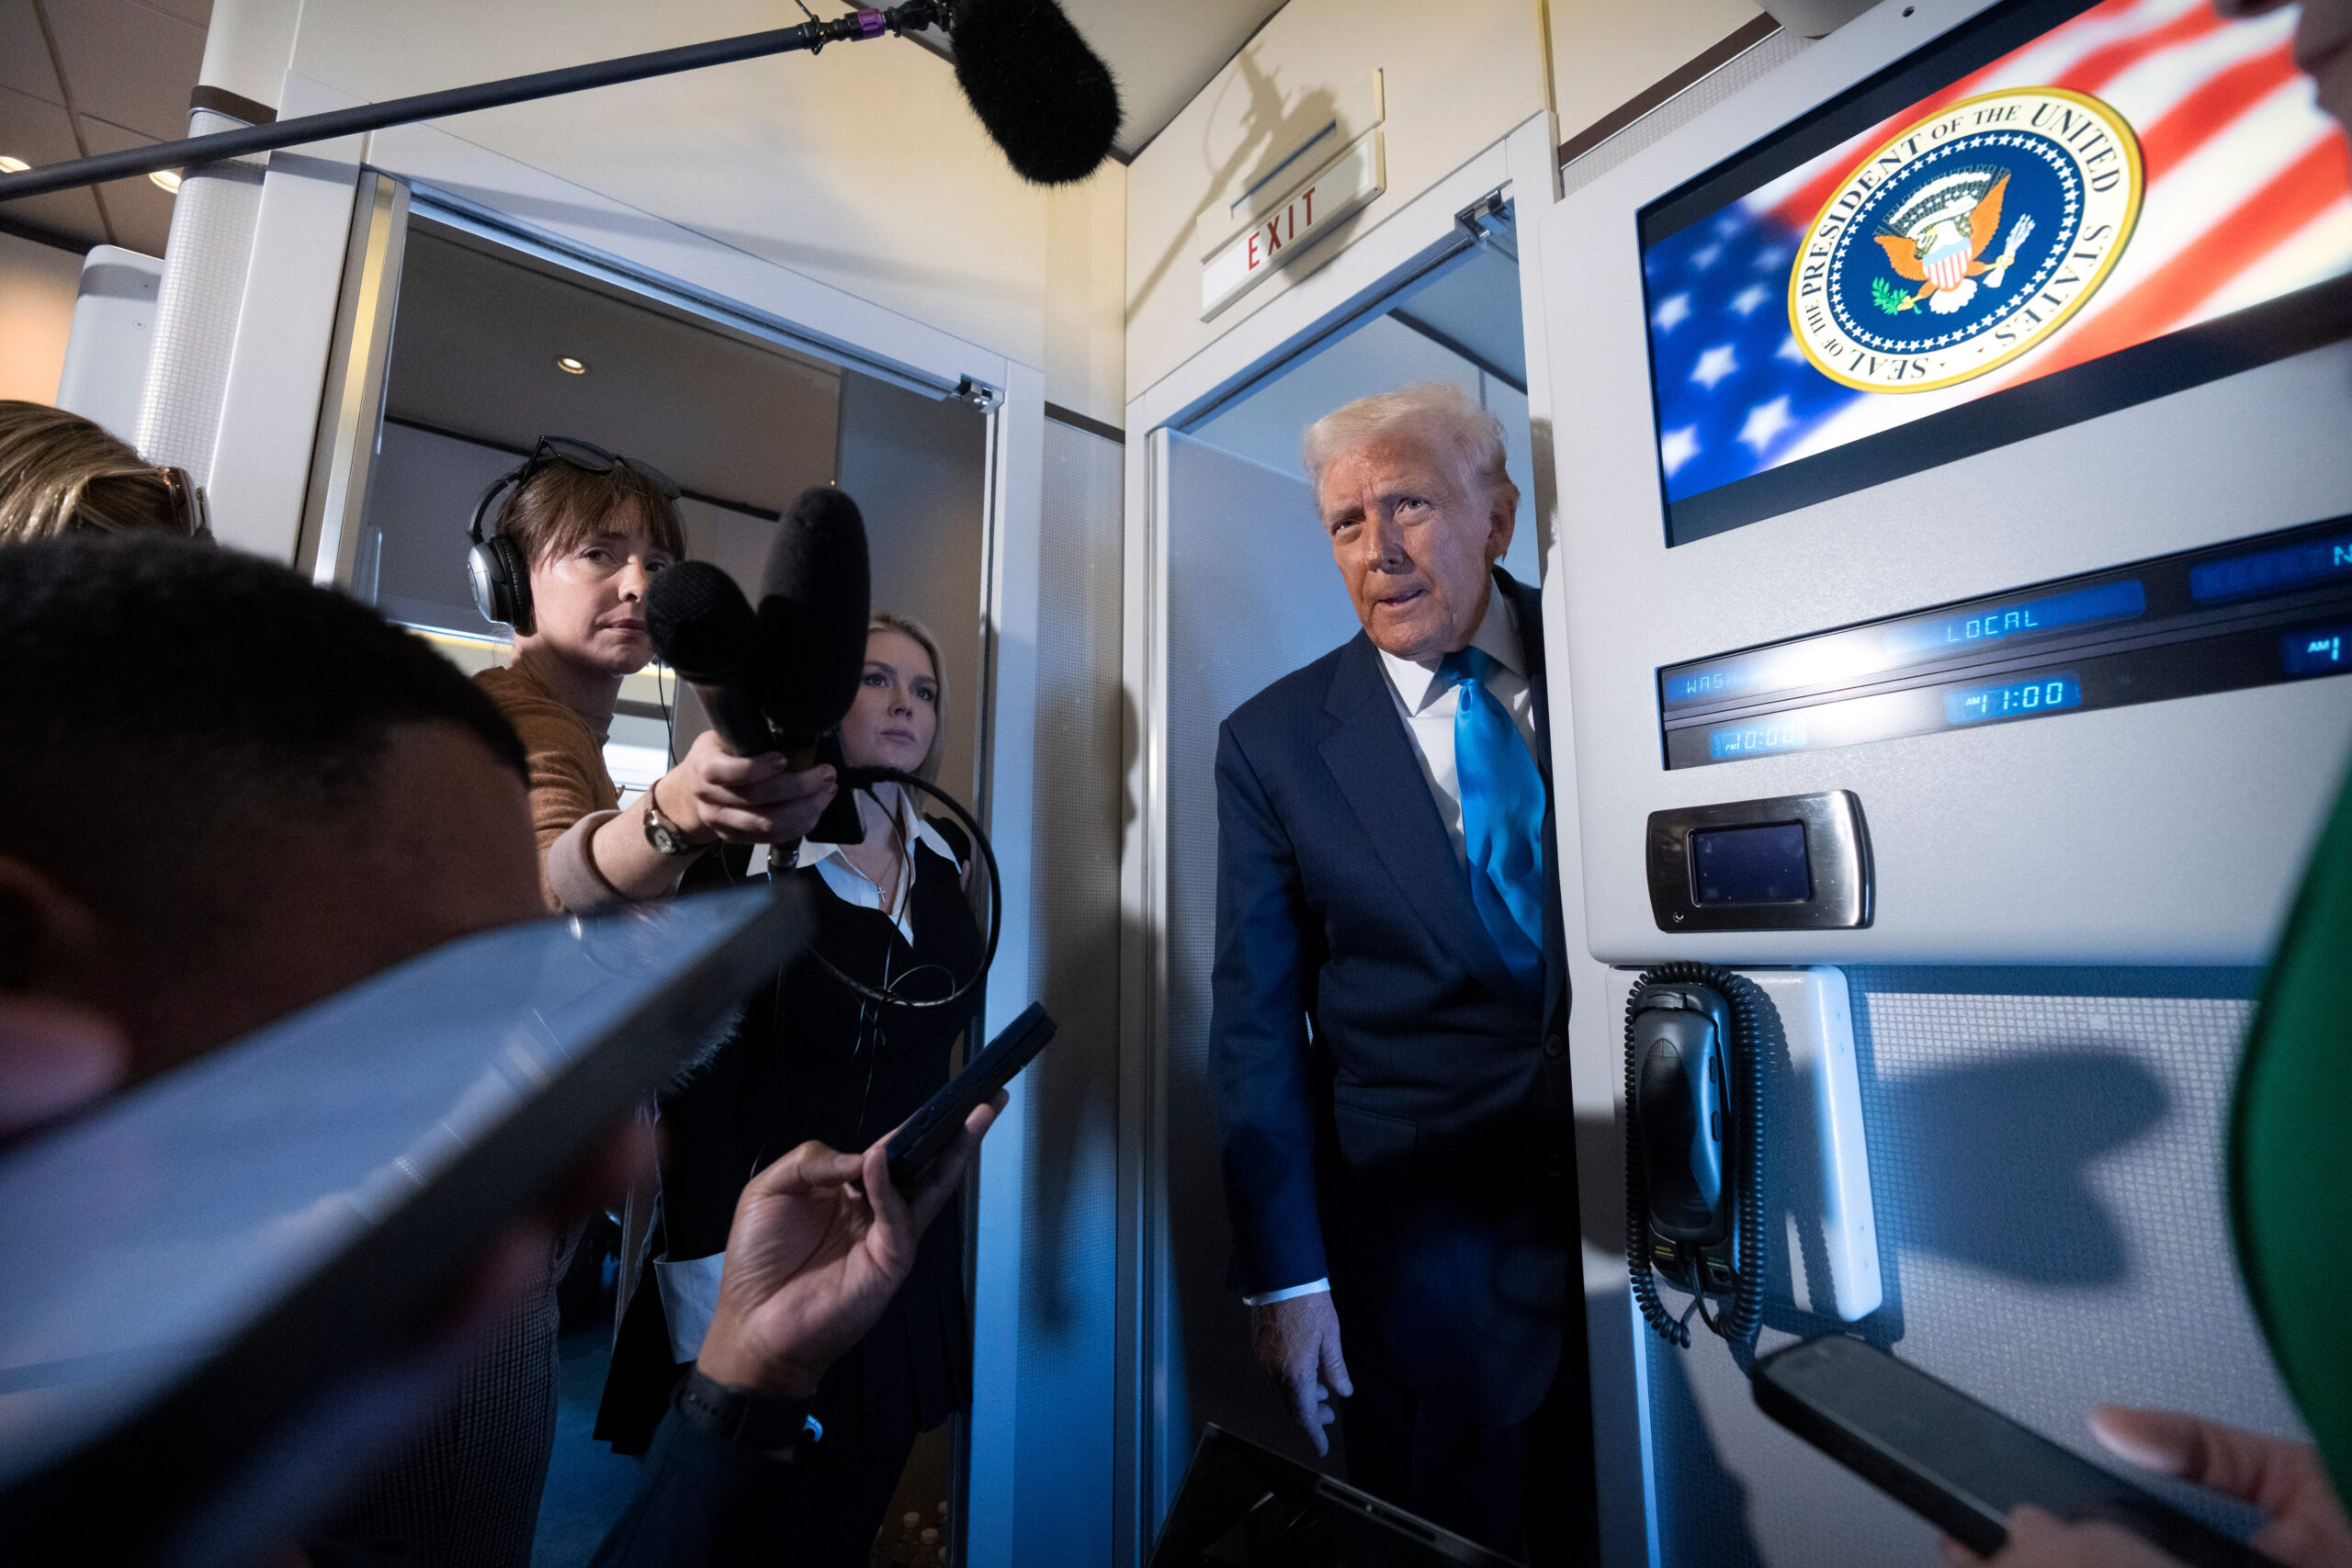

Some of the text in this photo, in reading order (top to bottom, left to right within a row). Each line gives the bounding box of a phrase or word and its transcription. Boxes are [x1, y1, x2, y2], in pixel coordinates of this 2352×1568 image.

[1249, 186, 1316, 271] EXIT
[1802, 103, 2121, 380] SEAL OF THE PRESIDENT OF THE UNITED STATES
[1947, 610, 2039, 642] LOCAL
[1981, 682, 2063, 714] 11:00
